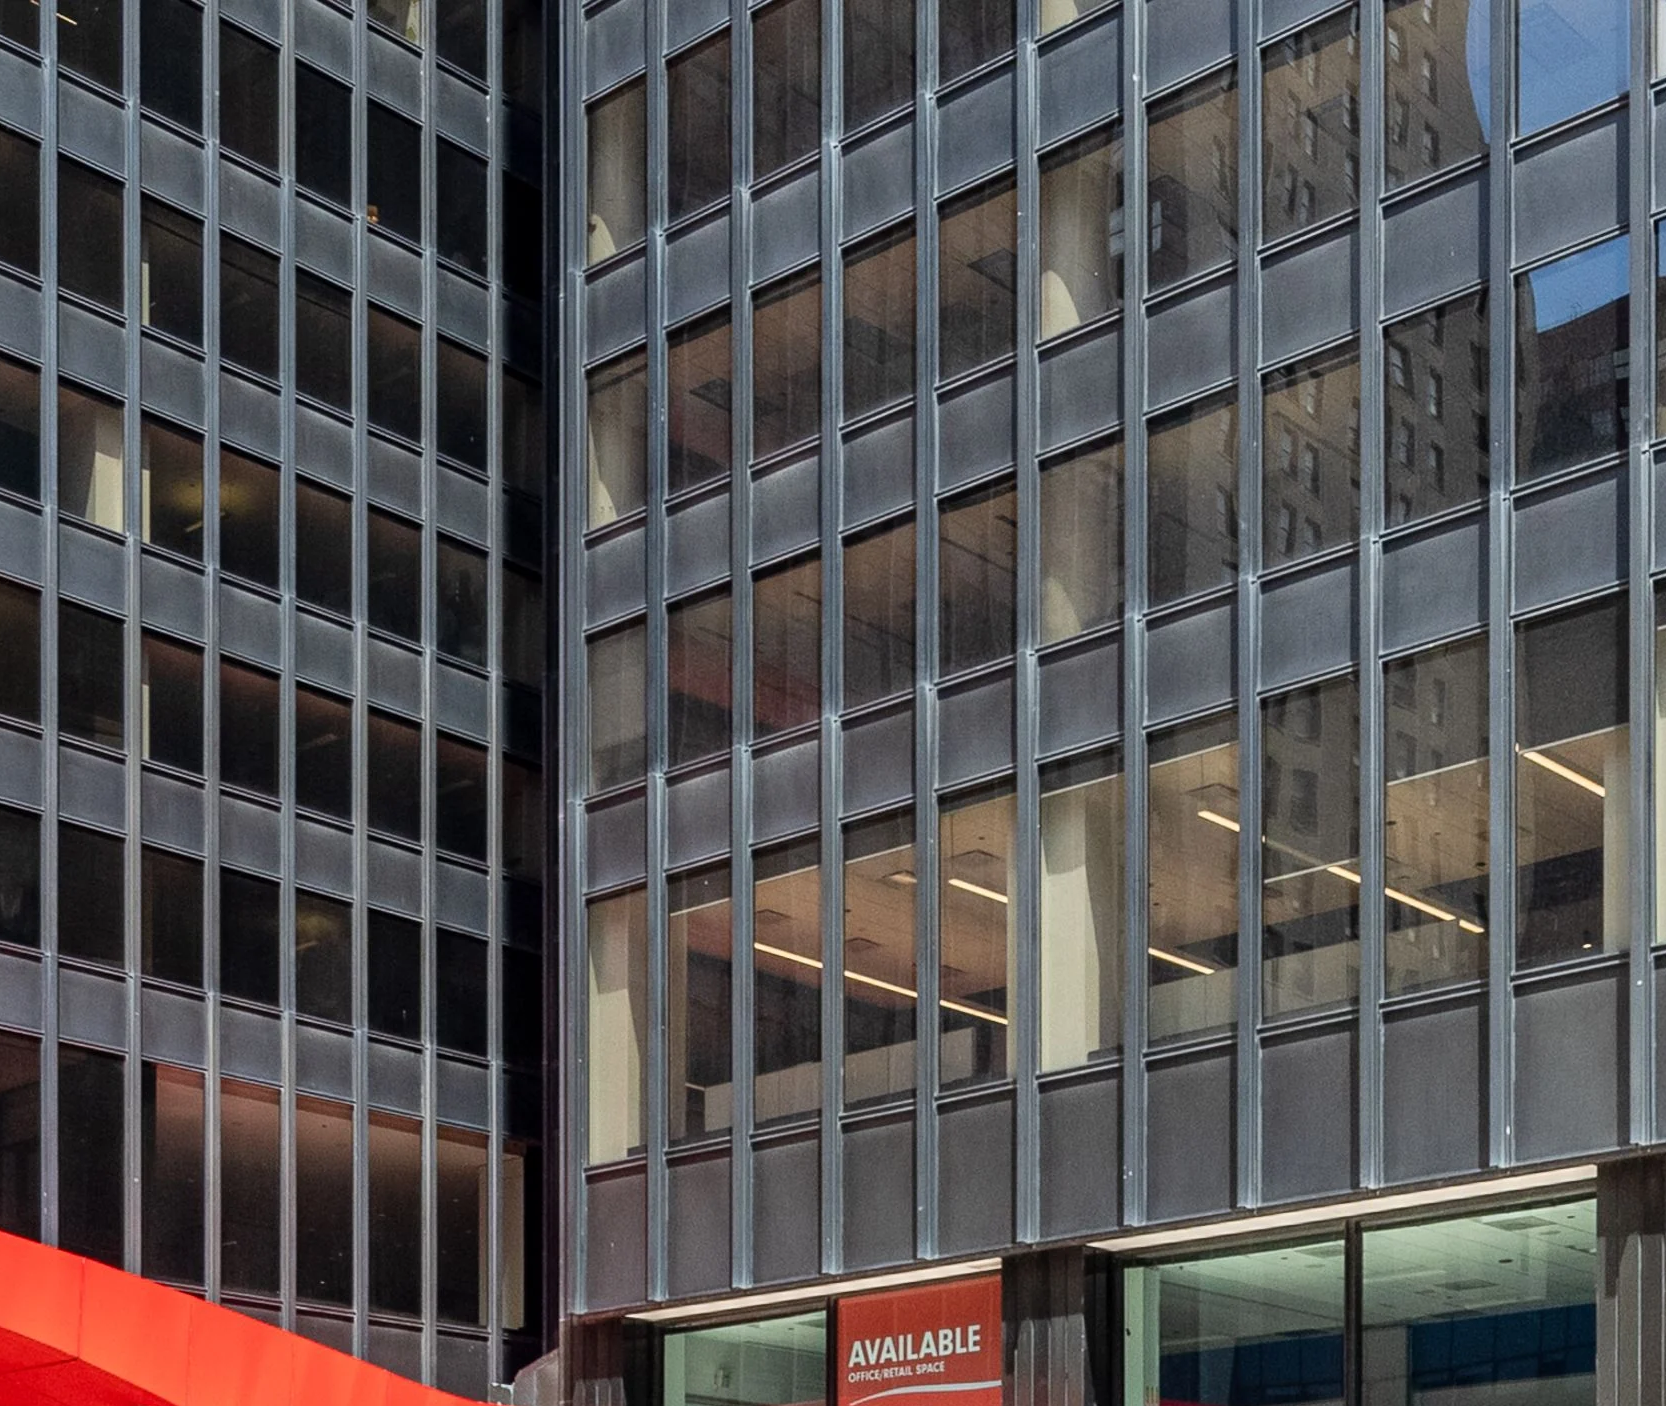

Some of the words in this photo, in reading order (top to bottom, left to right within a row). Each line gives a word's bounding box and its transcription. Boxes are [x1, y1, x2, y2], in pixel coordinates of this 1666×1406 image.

[848, 1324, 981, 1368] AVAILABLE
[848, 1368, 913, 1383] OFFICE/RETAIL
[916, 1361, 945, 1375] SPACE
